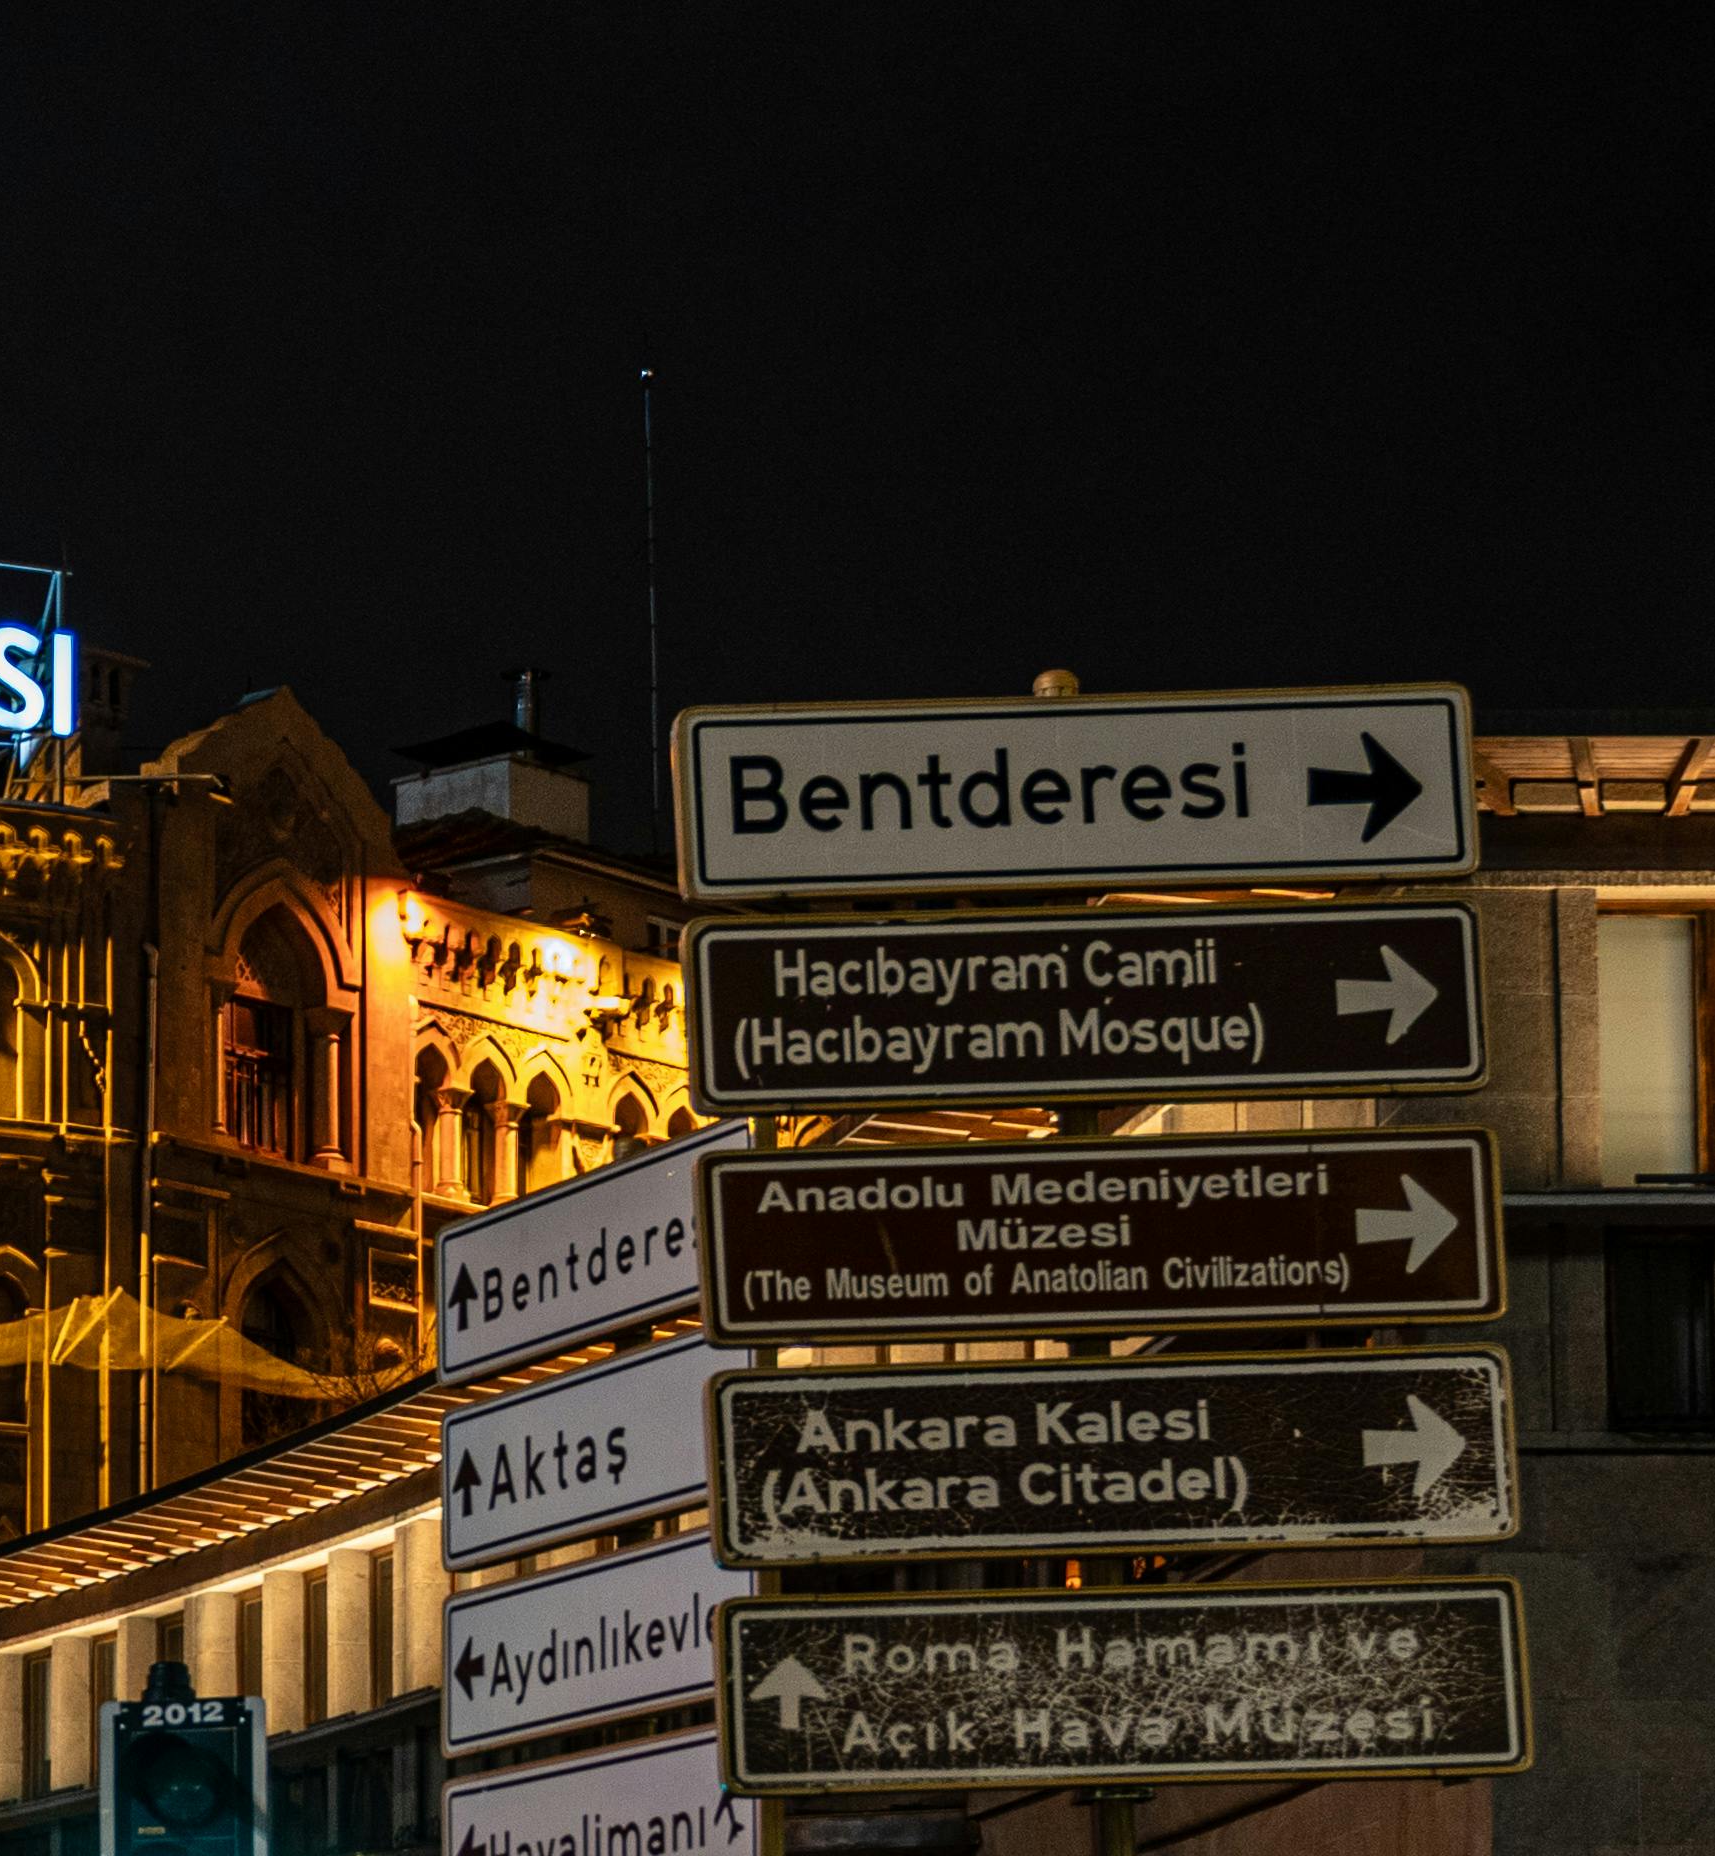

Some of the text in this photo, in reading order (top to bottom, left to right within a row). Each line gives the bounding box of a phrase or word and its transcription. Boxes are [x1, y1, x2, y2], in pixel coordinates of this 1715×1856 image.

[728, 742, 1250, 835] Bentderesi
[773, 938, 1217, 1005] Hacıbayram Camii
[733, 1003, 1264, 1079] (Hacıbayram Mosque)
[756, 1164, 1329, 1215] Anadolu Medeniyetleri
[956, 1214, 1131, 1253] Müzesi
[743, 1252, 1352, 1311] (The Museum of Anatolian Civilizations)
[797, 1400, 1211, 1454] Ankara Kalesi
[488, 1426, 628, 1511] Aktaş
[761, 1456, 1249, 1519] (Ankara Citadel)
[843, 1624, 1420, 1675] Roma Hamamı ve
[141, 1701, 225, 1728] 2012
[841, 1696, 1438, 1754] Açık Hava Müzesi
